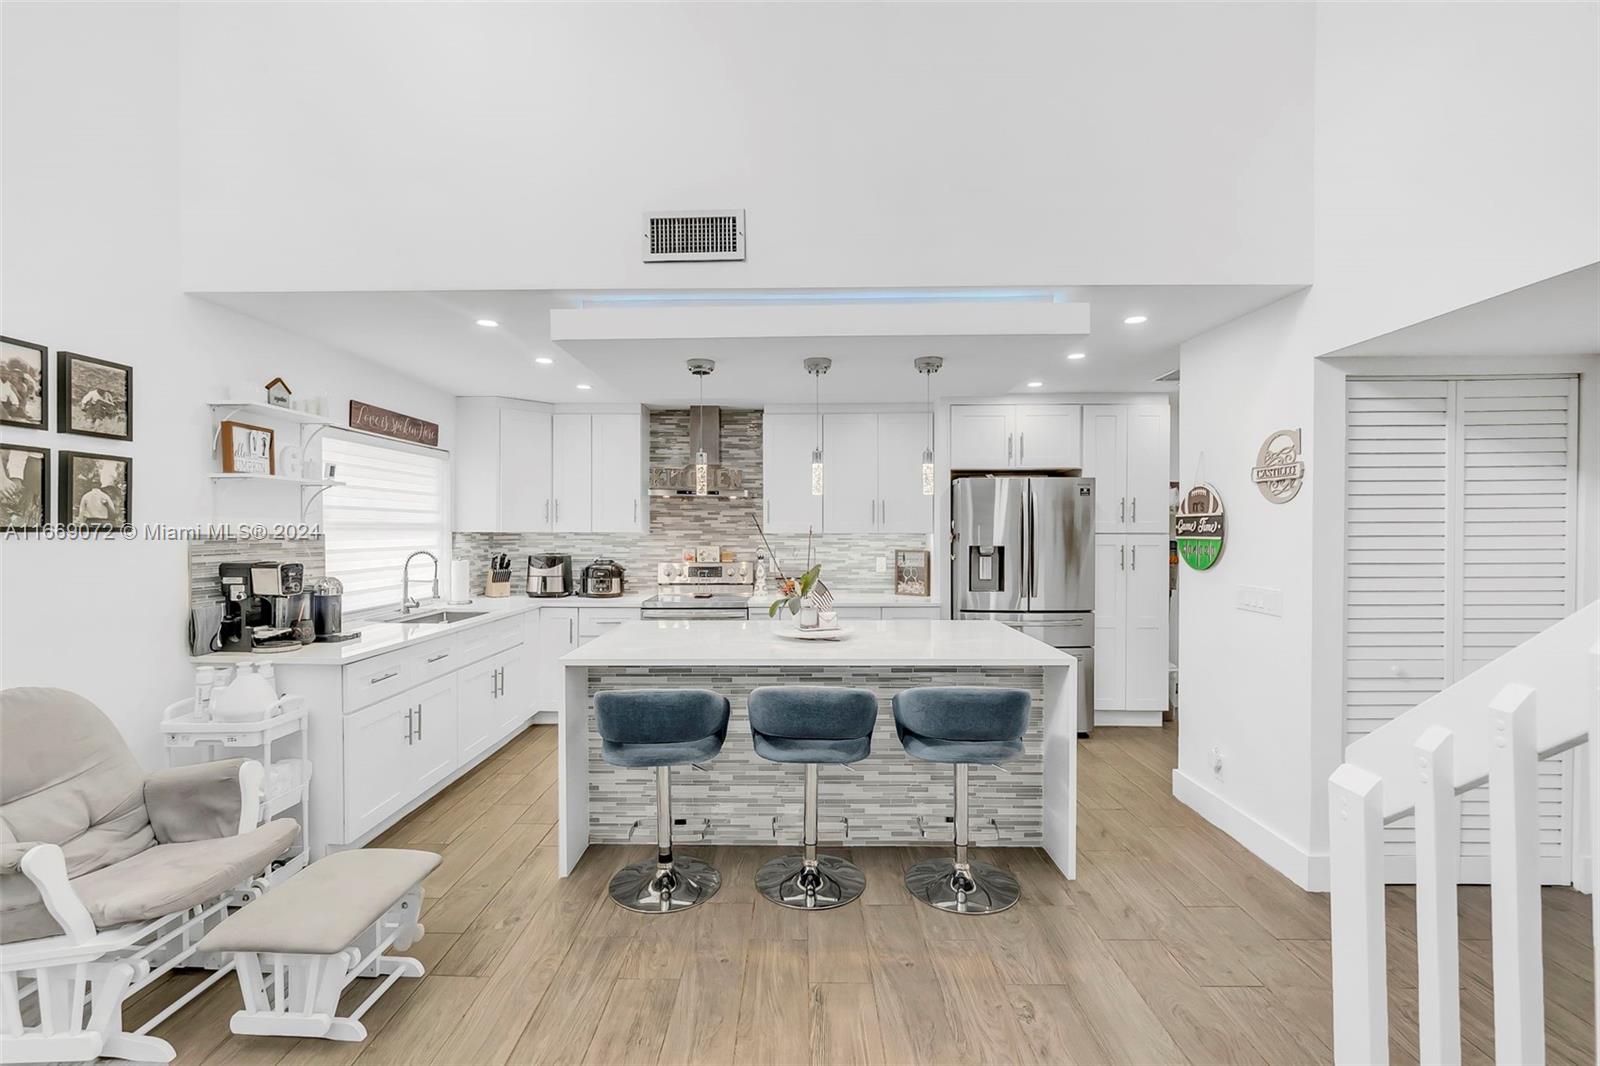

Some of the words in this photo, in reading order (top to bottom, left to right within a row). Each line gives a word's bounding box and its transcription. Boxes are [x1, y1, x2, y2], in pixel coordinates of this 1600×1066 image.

[356, 405, 379, 426] Love
[1256, 465, 1297, 480] CASTILLO
[1192, 502, 1205, 512] IT'S
[1177, 518, 1197, 534] Game
[1197, 517, 1217, 533] Time
